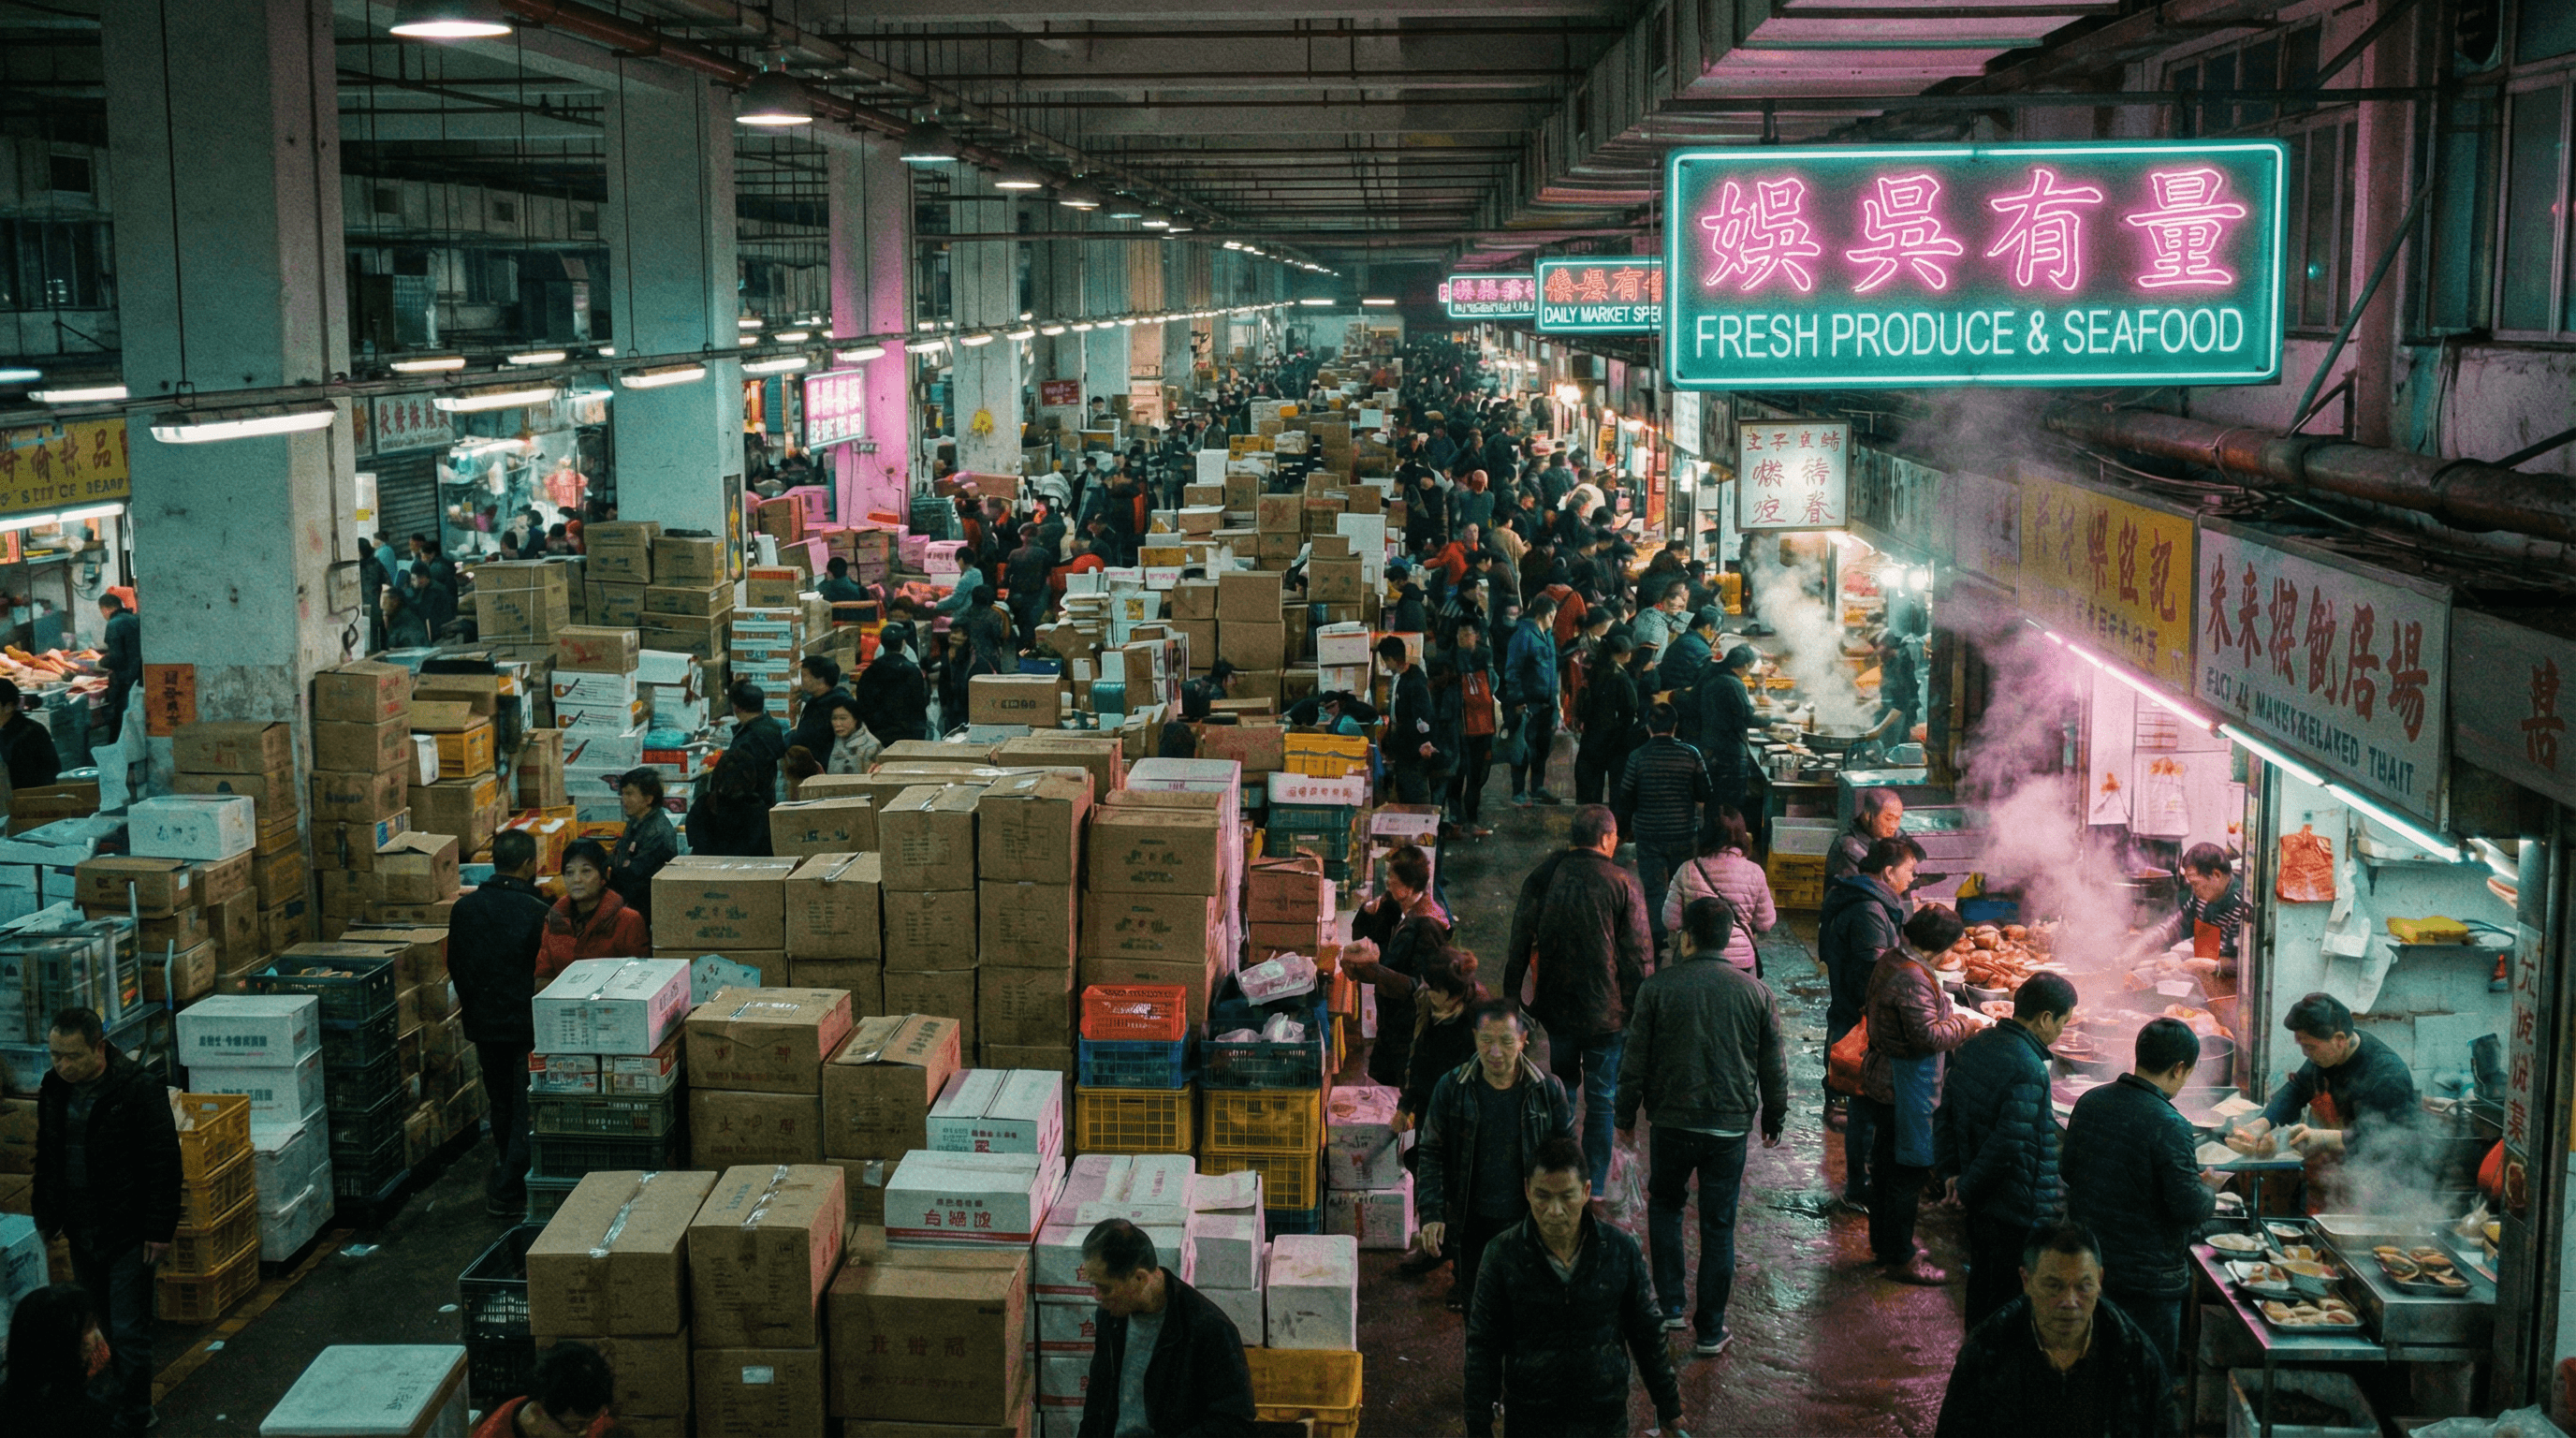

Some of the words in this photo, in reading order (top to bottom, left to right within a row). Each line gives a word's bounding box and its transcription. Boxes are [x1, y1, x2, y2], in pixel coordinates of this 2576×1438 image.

[1544, 306, 1578, 323] DAILY
[1580, 306, 1631, 322] MARKET
[1696, 314, 1818, 359] FRESH
[1832, 310, 2015, 357] PRODUCE
[2027, 310, 2050, 355] &
[2063, 308, 2243, 354] SEAFOOD
